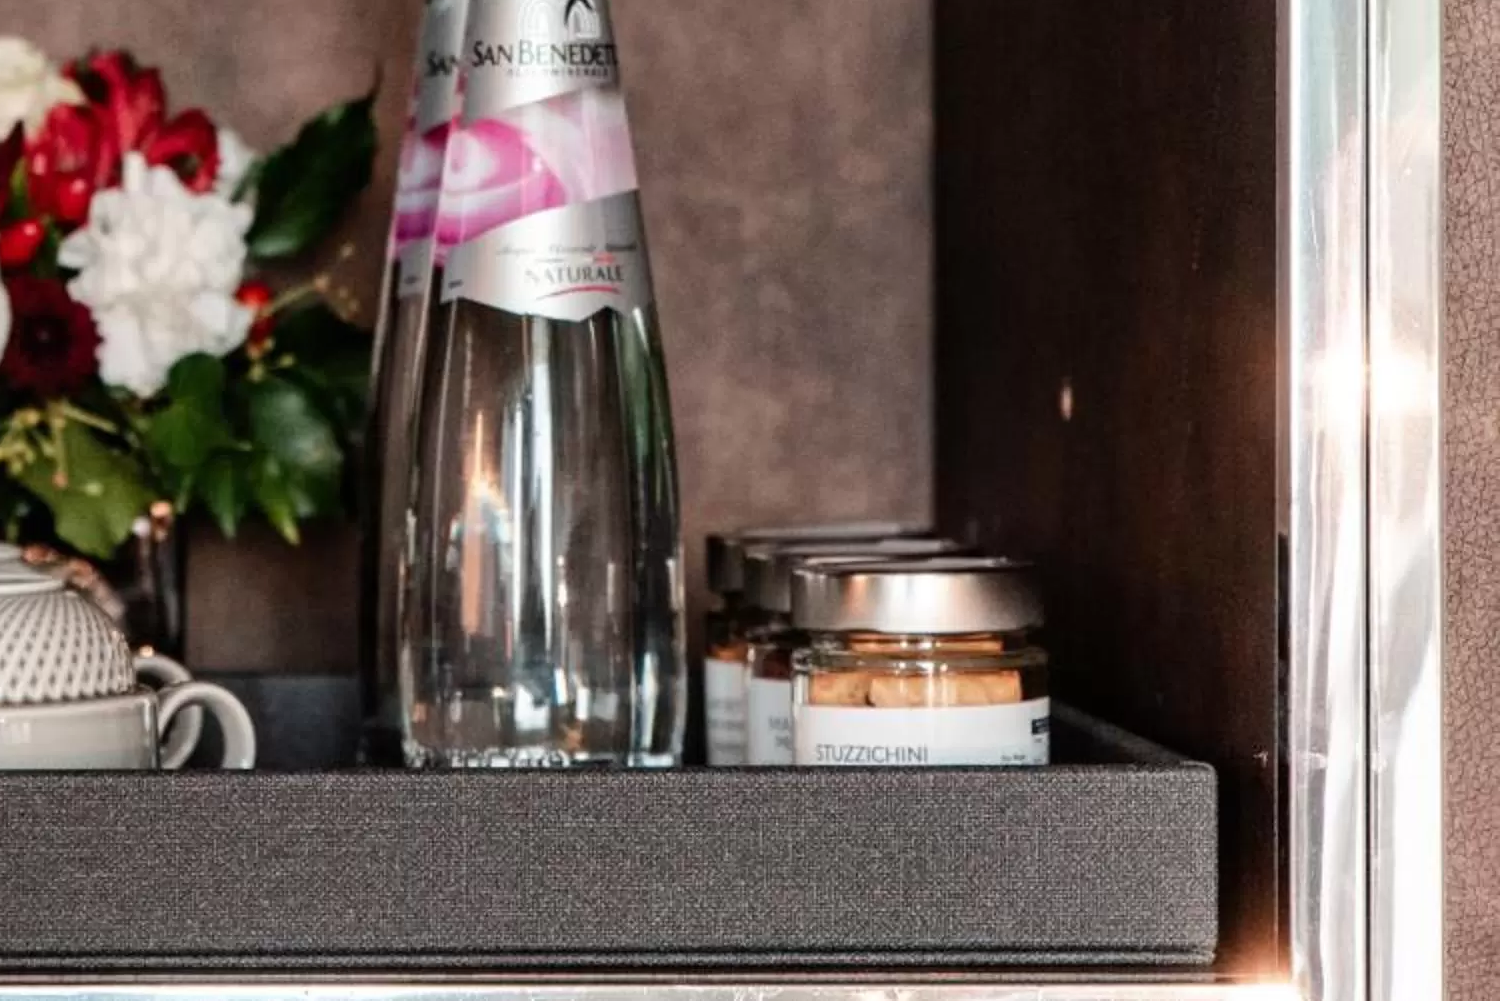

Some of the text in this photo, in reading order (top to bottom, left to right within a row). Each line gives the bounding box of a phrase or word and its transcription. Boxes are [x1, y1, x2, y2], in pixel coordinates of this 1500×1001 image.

[471, 38, 617, 68] SAN BENEDET
[524, 265, 624, 284] NATURALE
[815, 743, 929, 764] STUZZICHINI
